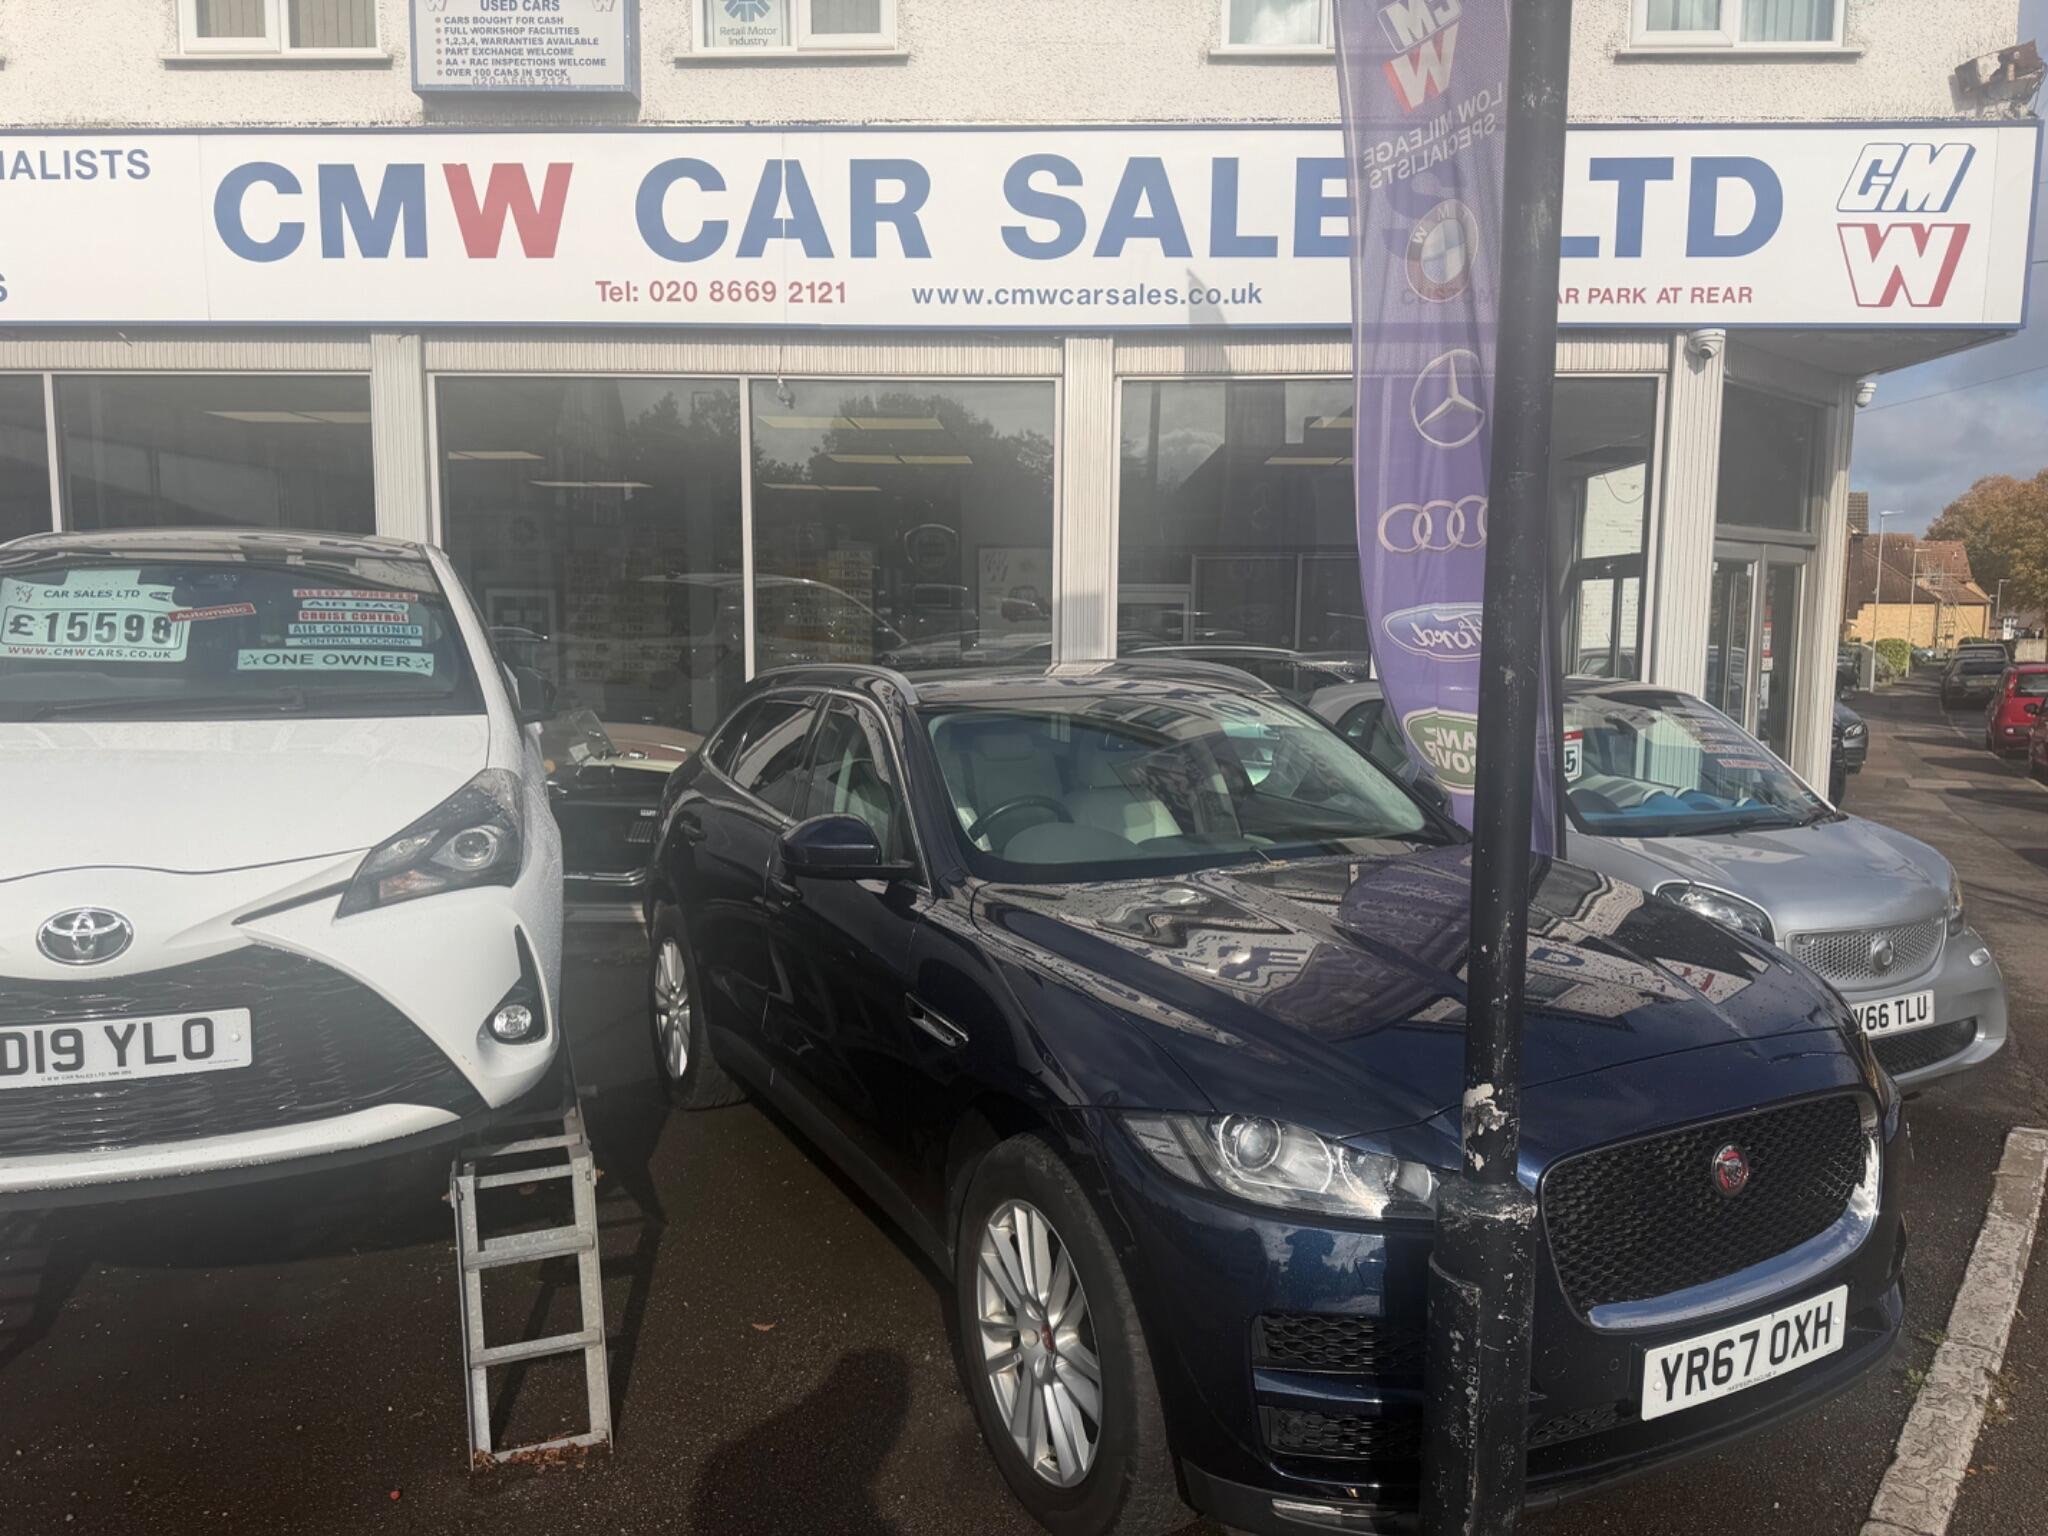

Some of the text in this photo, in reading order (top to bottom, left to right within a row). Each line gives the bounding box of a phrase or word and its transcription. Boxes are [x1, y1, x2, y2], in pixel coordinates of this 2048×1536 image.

[480, 0, 560, 12] USED CARS
[444, 17, 564, 25] CARS BOUGHT FOR CASH
[444, 27, 580, 35] FULL WORKSHOP FACILITIES
[719, 27, 777, 36] Retail Motor
[481, 37, 544, 46] WARRANTIES
[546, 37, 599, 46] AVAILABLE
[728, 37, 768, 47] Industry
[445, 48, 574, 56] PART EXCHANGE WELCOME
[445, 58, 460, 66] AA
[469, 58, 489, 66] RAC
[491, 58, 556, 66] INSPECTIONS
[558, 58, 606, 66] WELCOME
[445, 68, 567, 77] OVER 100 CARS IN STOCK
[1836, 143, 1977, 213] CM
[213, 160, 574, 263] CMW
[635, 156, 933, 263] CAR
[1836, 222, 1971, 308] W
[595, 280, 847, 304] Tel: 020 8669 2121
[912, 281, 1263, 306] www.cmwcarsales.co.uk
[1587, 287, 1648, 304] PARK
[1656, 287, 1683, 304] AT
[1690, 286, 1753, 304] REAR
[44, 589, 71, 599] CAR
[73, 589, 112, 599] SALES
[116, 589, 140, 599] LTD
[352, 612, 407, 622] CONTROL
[294, 624, 418, 635] AIR CONDITIONED
[8, 645, 172, 660] WWW.CMWCARS.CO.UK
[262, 653, 412, 668] ONE OWNER
[1894, 995, 1927, 1026] TLU
[104, 1017, 214, 1068] YLO
[1661, 1301, 1833, 1403] YR67 OXH
